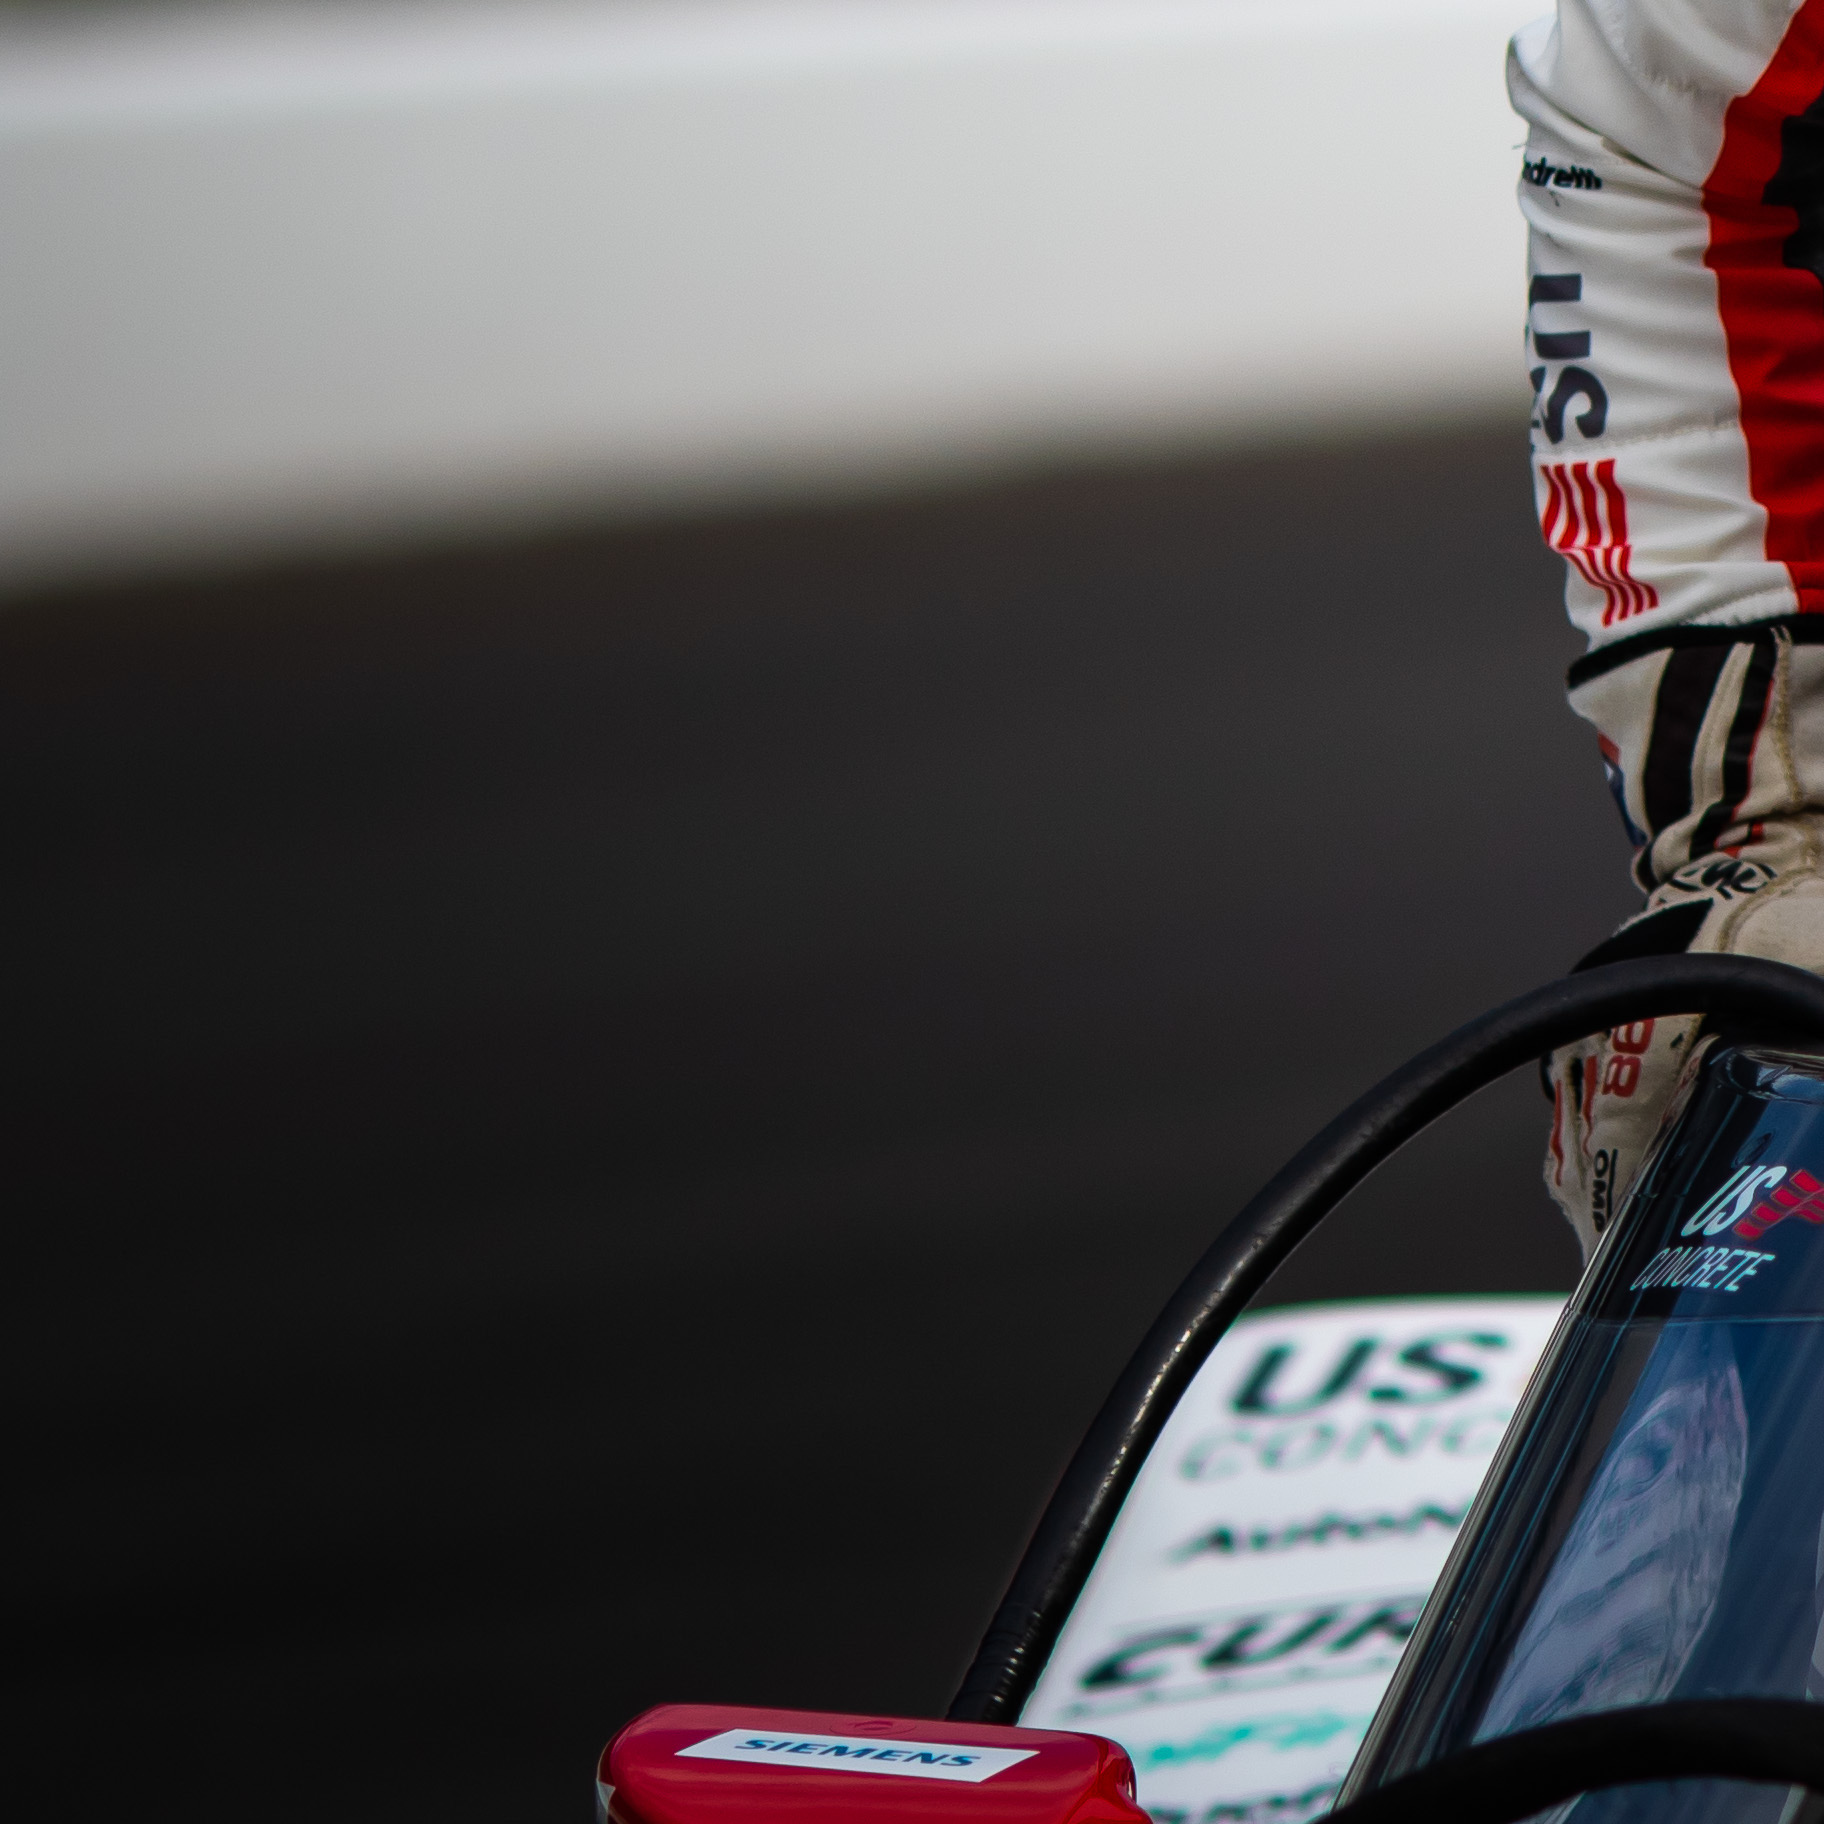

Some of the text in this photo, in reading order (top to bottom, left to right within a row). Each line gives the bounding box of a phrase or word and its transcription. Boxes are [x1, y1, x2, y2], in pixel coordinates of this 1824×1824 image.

[1680, 1165, 1788, 1237] US
[1629, 1245, 1777, 1293] CONCRETE
[1230, 1332, 1510, 1418] US
[734, 1738, 982, 1767] SIEMENS
